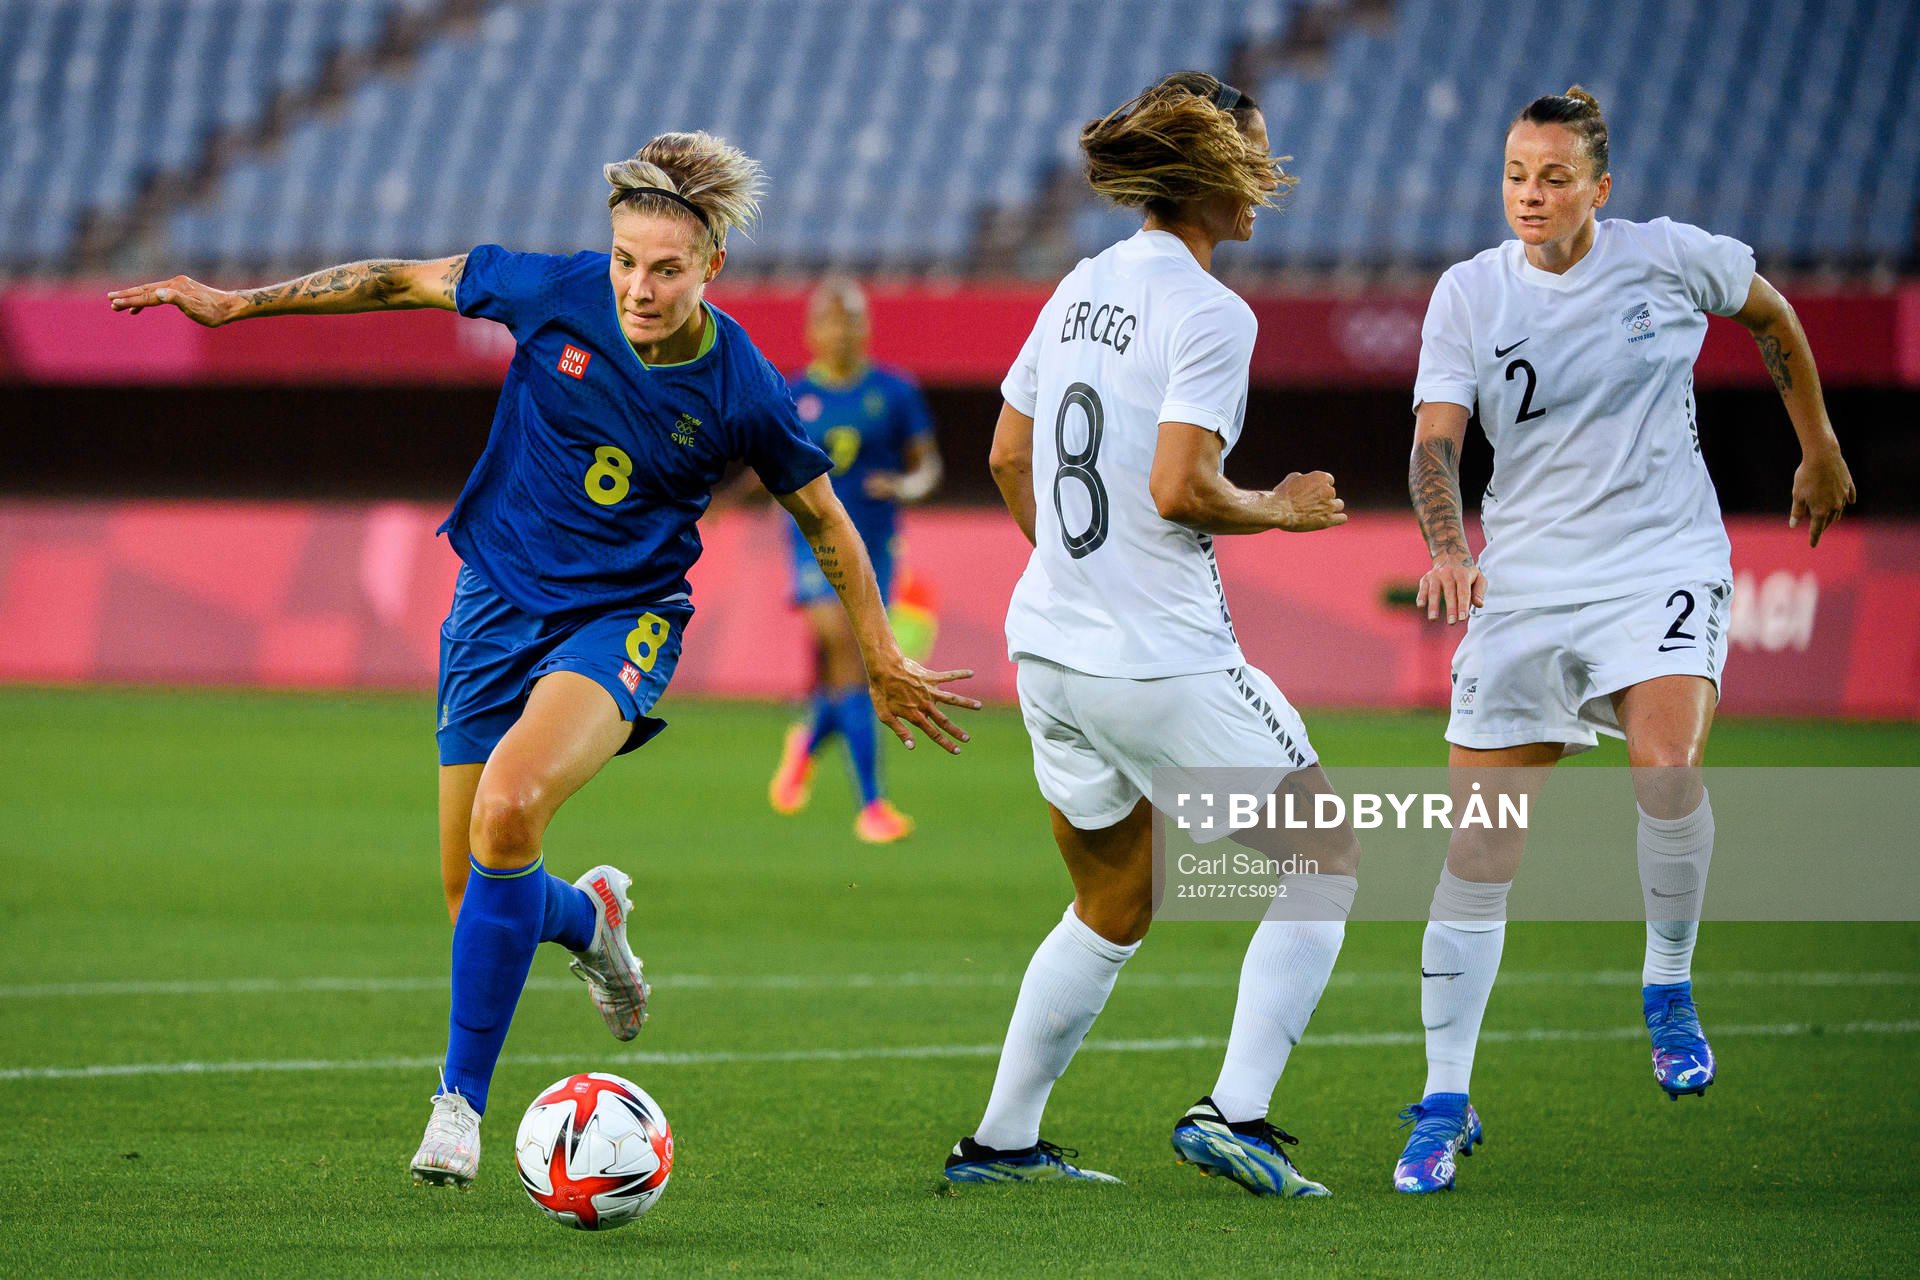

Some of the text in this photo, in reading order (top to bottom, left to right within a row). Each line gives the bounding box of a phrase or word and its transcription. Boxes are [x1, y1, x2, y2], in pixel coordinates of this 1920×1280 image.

[1060, 301, 1137, 355] ERCEG
[1627, 335, 1643, 343] TOKYO
[561, 359, 582, 375] QLO
[565, 348, 585, 365] UNI
[1505, 358, 1547, 424] 2
[671, 432, 695, 448] SWE
[584, 445, 633, 505] 8
[1053, 381, 1109, 560] 8
[1664, 589, 1697, 640] 2
[625, 611, 671, 673] 8
[622, 672, 635, 690] QLO
